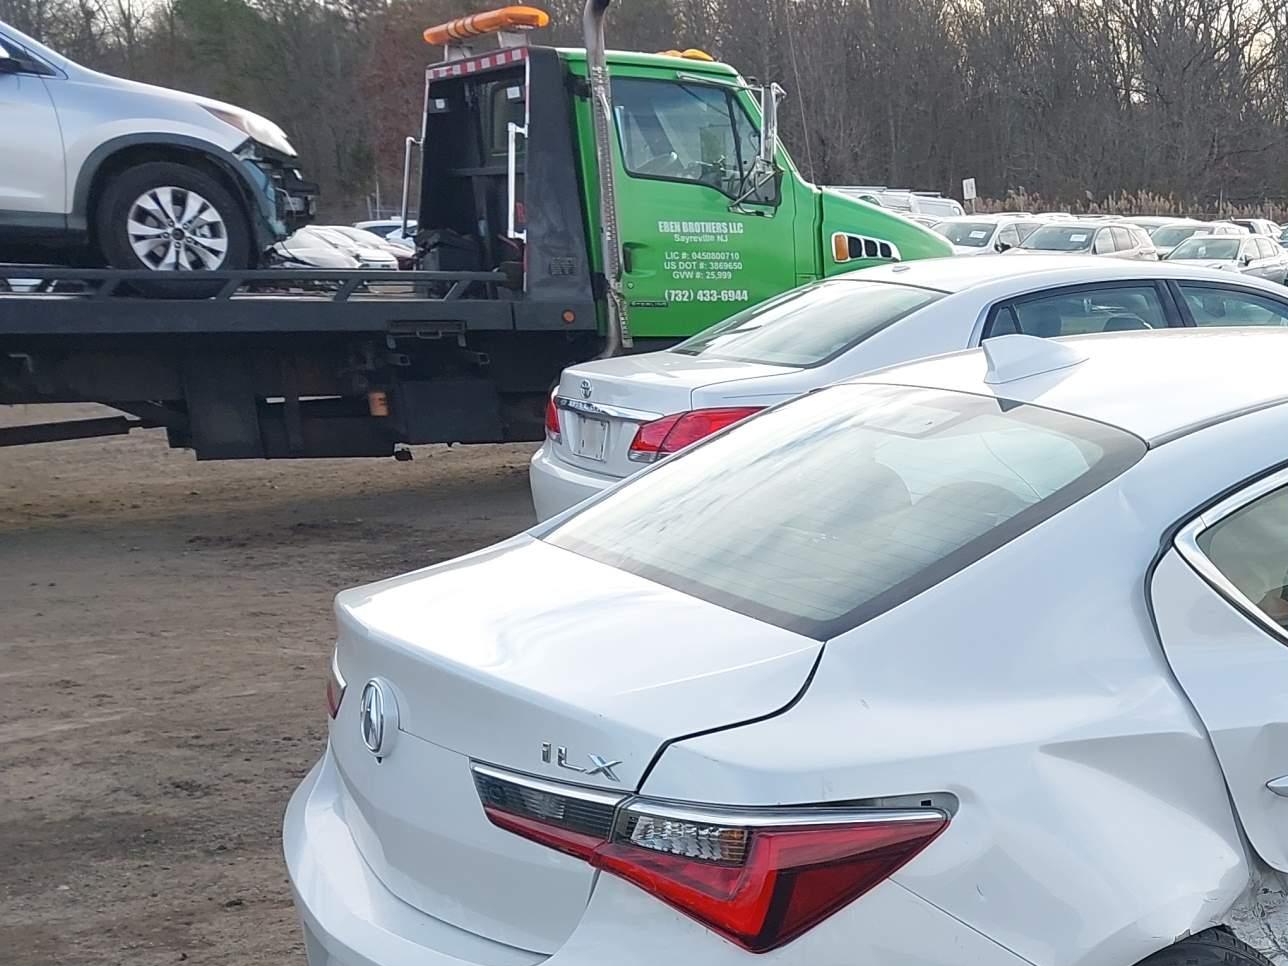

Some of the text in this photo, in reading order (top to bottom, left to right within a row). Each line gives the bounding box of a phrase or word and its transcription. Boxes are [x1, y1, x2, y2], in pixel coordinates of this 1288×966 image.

[682, 221, 728, 234] BROTHERS
[729, 222, 744, 234] LLC
[674, 234, 715, 243] Sayreville
[664, 262, 677, 270] US
[678, 262, 697, 270] DOT
[665, 289, 748, 302] (732) 433-6944
